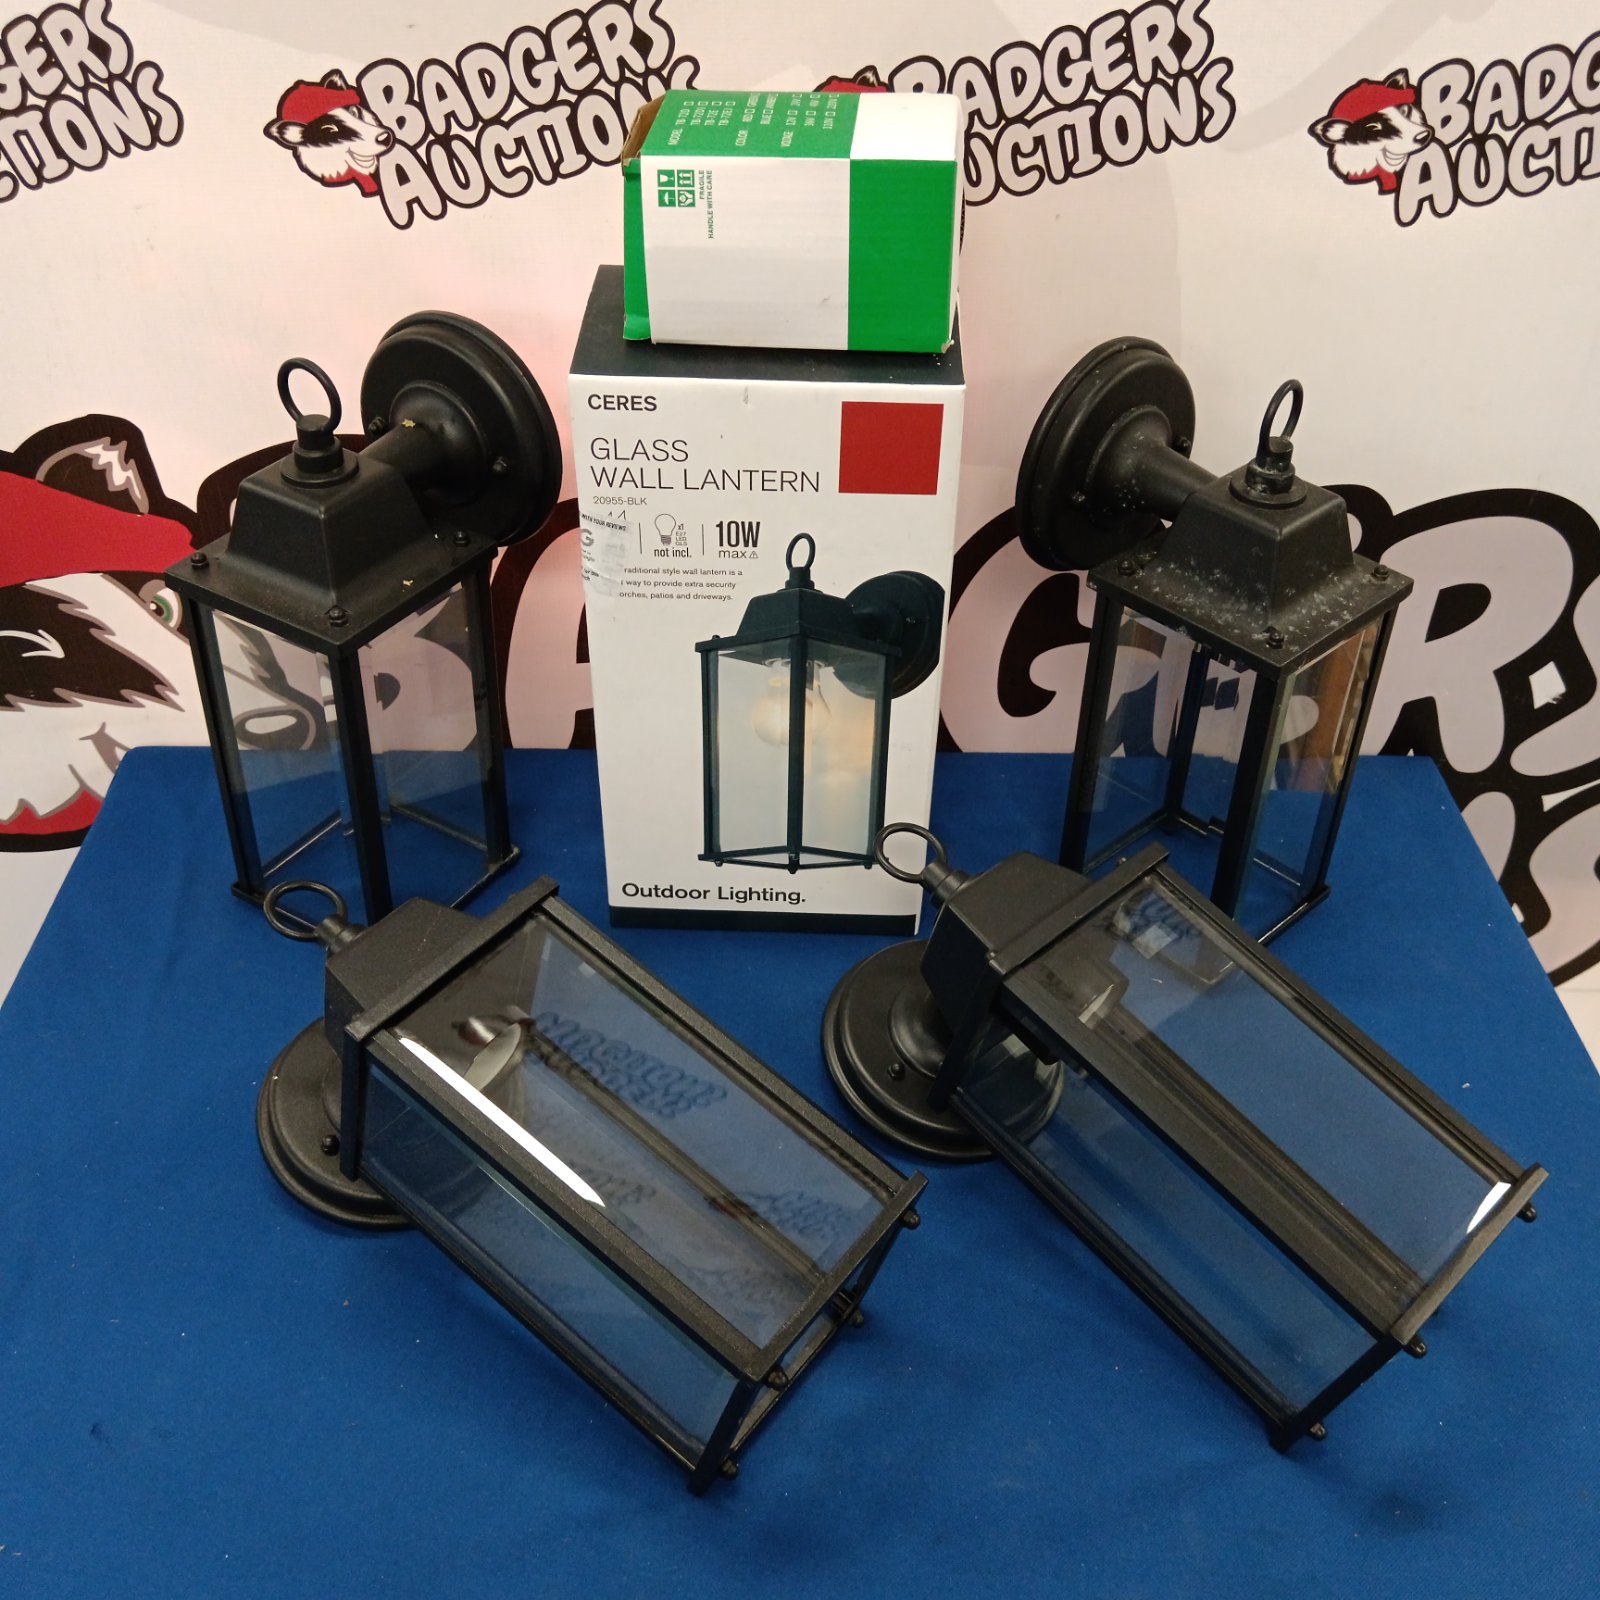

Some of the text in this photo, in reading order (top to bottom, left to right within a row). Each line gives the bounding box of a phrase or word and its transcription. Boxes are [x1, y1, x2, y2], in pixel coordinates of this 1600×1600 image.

[356, 0, 675, 149] BADGERS
[964, 57, 1236, 206] UCTIONS
[587, 393, 658, 412] CERES
[590, 437, 689, 462] GLASS
[590, 465, 821, 493] WALL LANTERN
[592, 496, 648, 506] 20955-BLK
[715, 520, 761, 548] 10W
[654, 547, 692, 559] not incl.
[718, 550, 747, 559] max
[662, 568, 680, 576] style
[625, 580, 641, 588] way
[653, 580, 683, 588] provide
[705, 581, 736, 589] security
[619, 591, 733, 601] orches, patios and driveways.
[621, 882, 807, 905] Outdoor Lighting.
